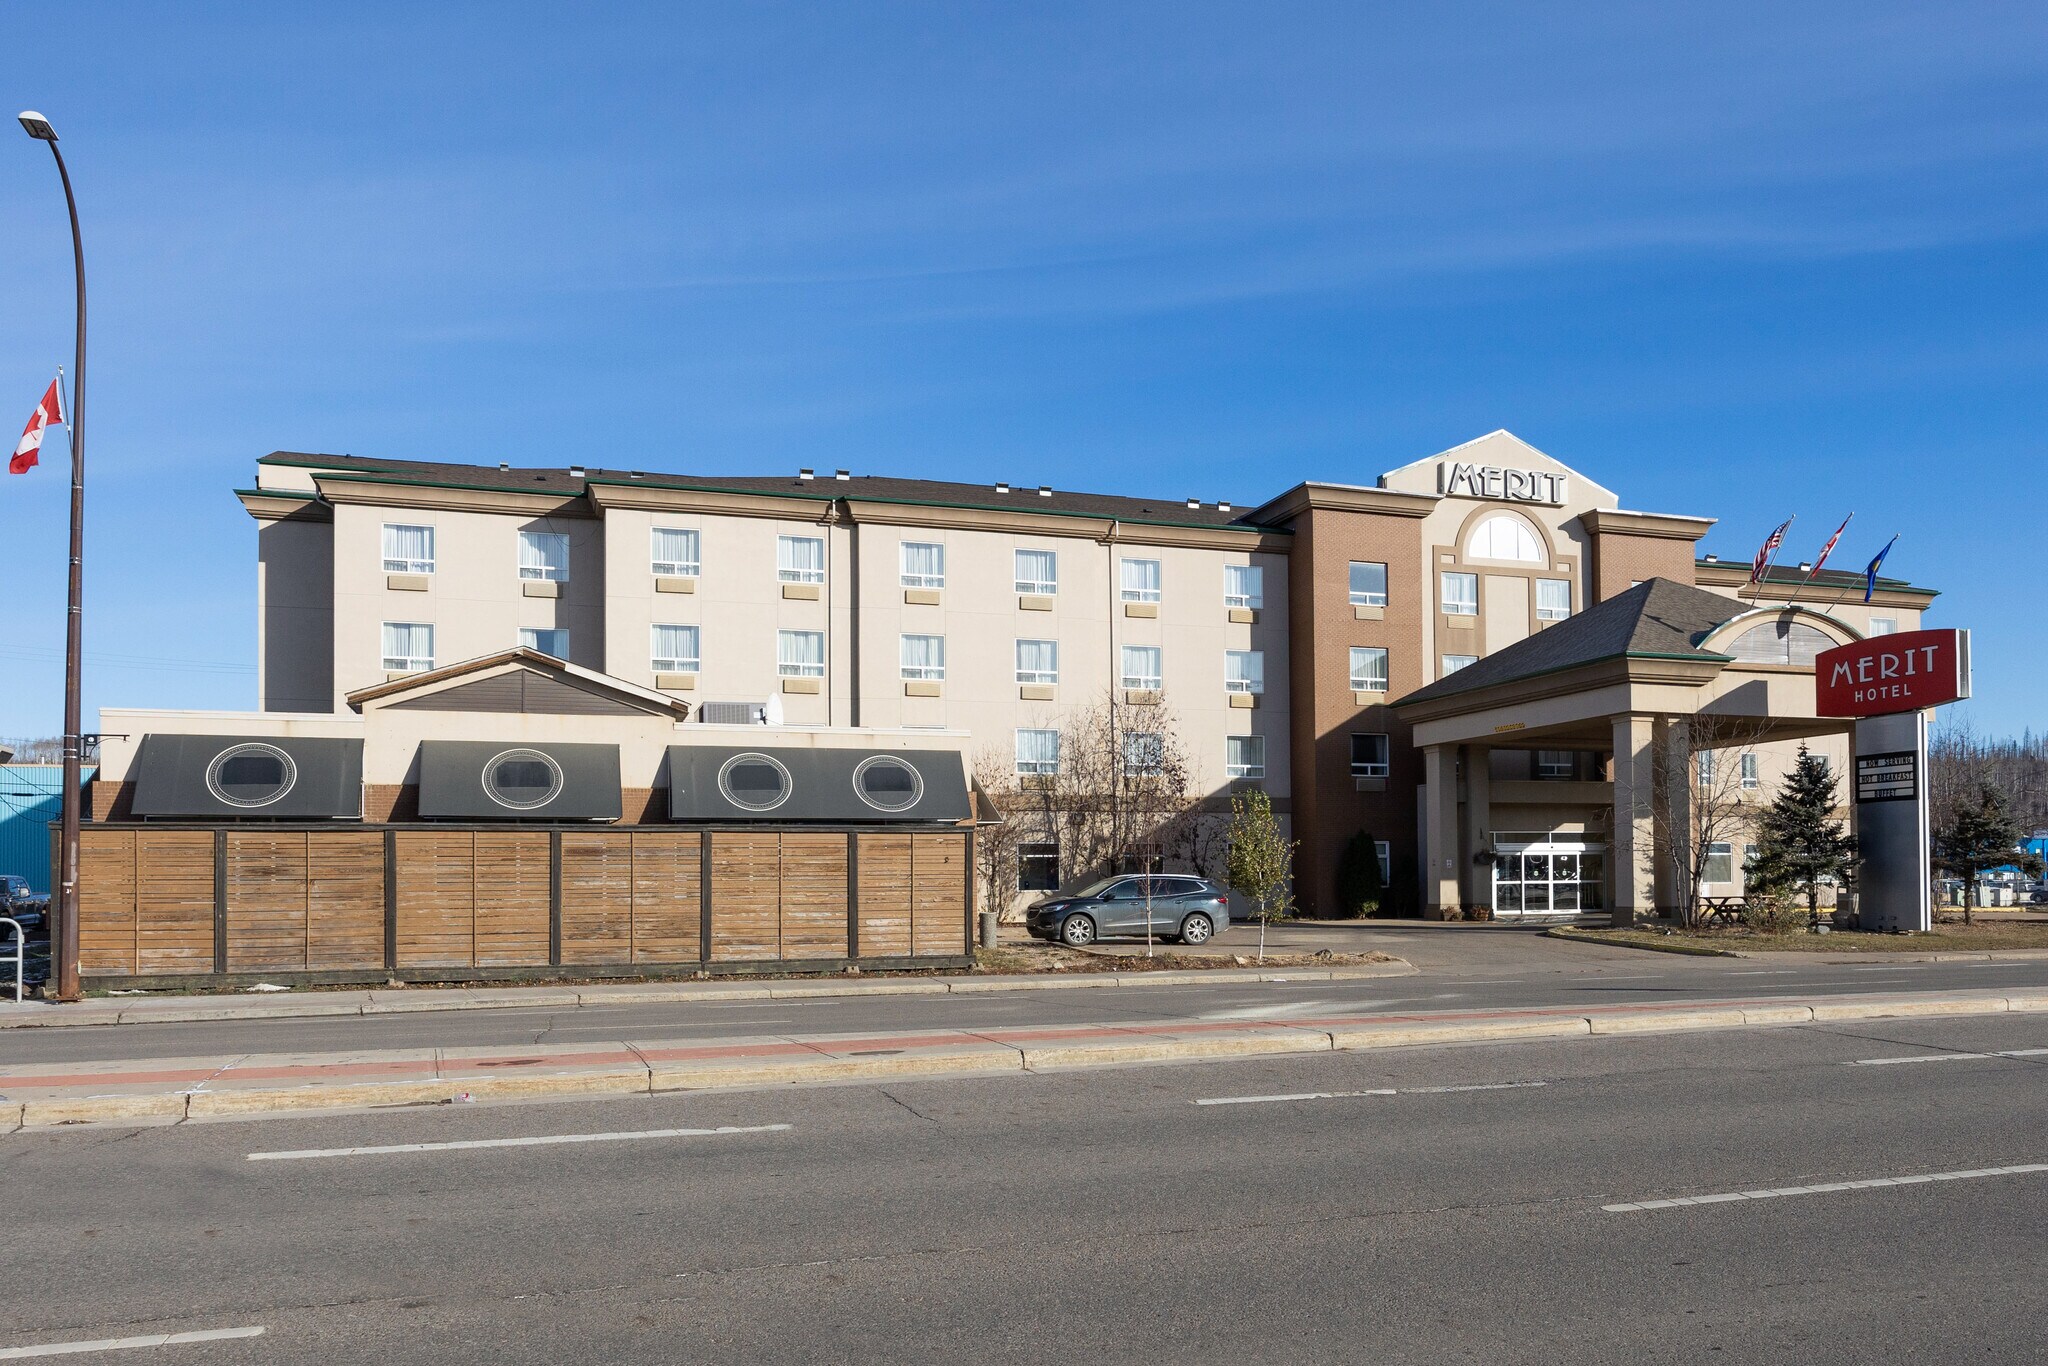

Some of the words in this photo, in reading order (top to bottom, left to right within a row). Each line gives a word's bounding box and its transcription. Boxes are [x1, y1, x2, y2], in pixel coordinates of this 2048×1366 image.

[1448, 462, 1566, 503] MERIT
[1830, 645, 1939, 688] MERIT
[1855, 684, 1912, 702] HOTEL
[1885, 757, 1912, 766] SERVING
